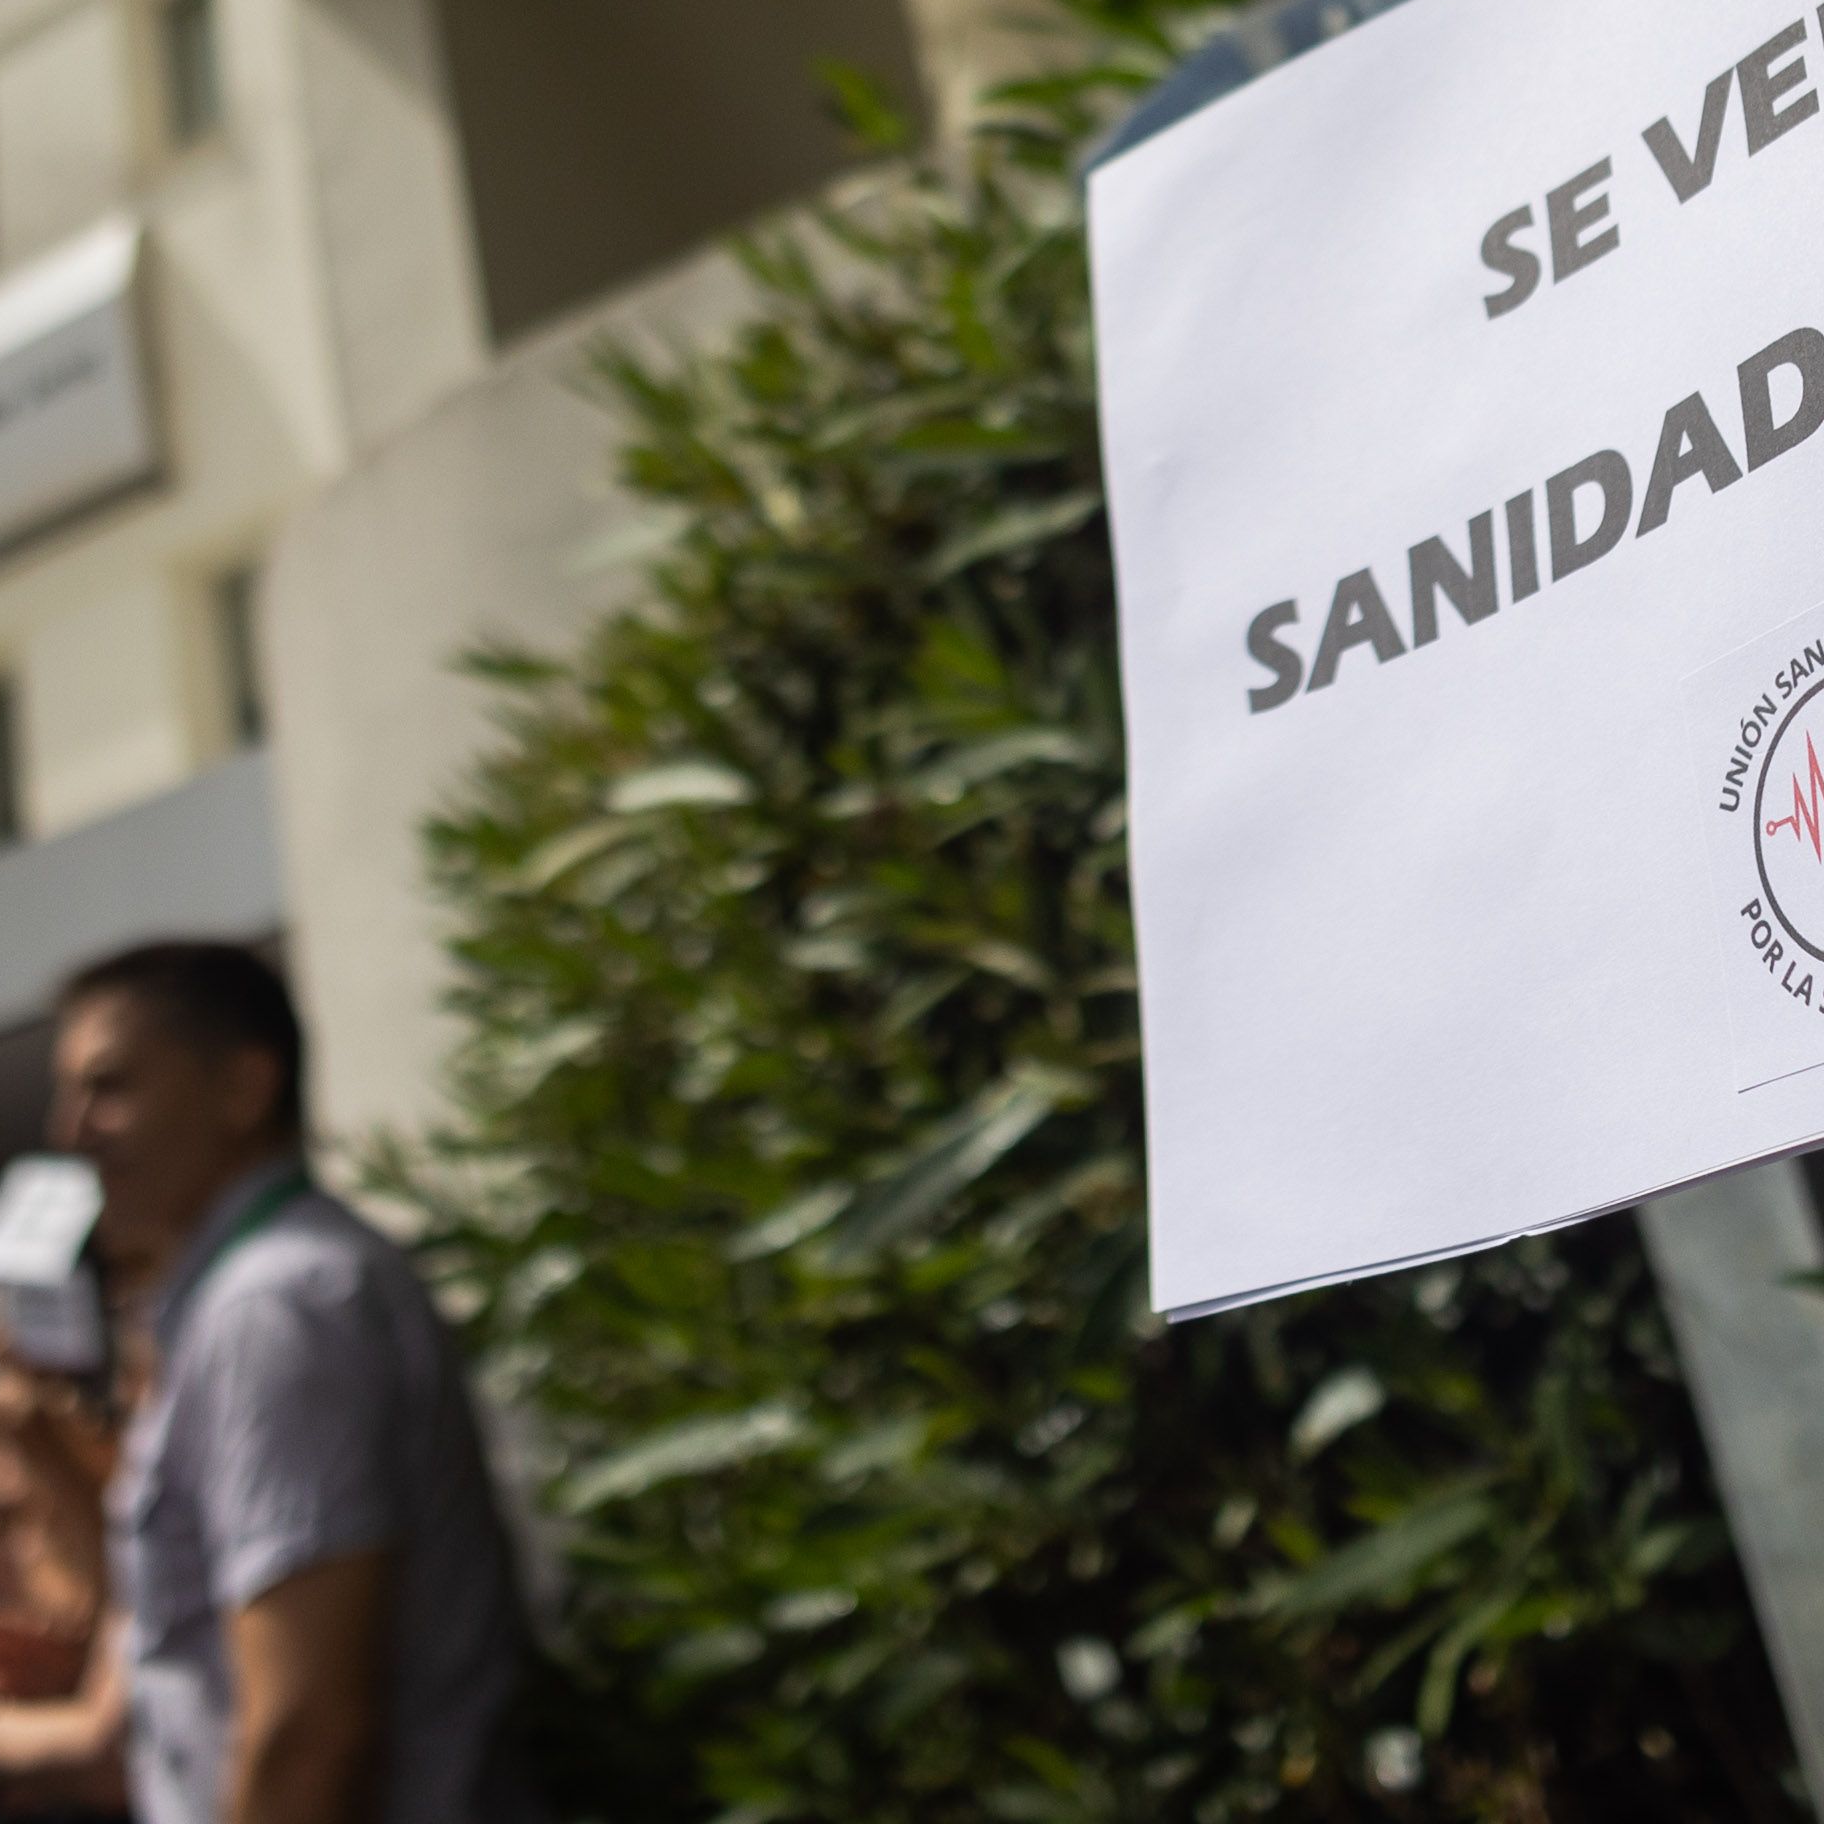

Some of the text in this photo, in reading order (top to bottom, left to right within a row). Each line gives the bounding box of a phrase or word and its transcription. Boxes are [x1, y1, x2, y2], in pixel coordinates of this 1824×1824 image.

[1480, 156, 1620, 319] SE
[1718, 692, 1779, 814] UNIÓN
[1739, 896, 1785, 975] POR
[1779, 959, 1814, 1008] LA
